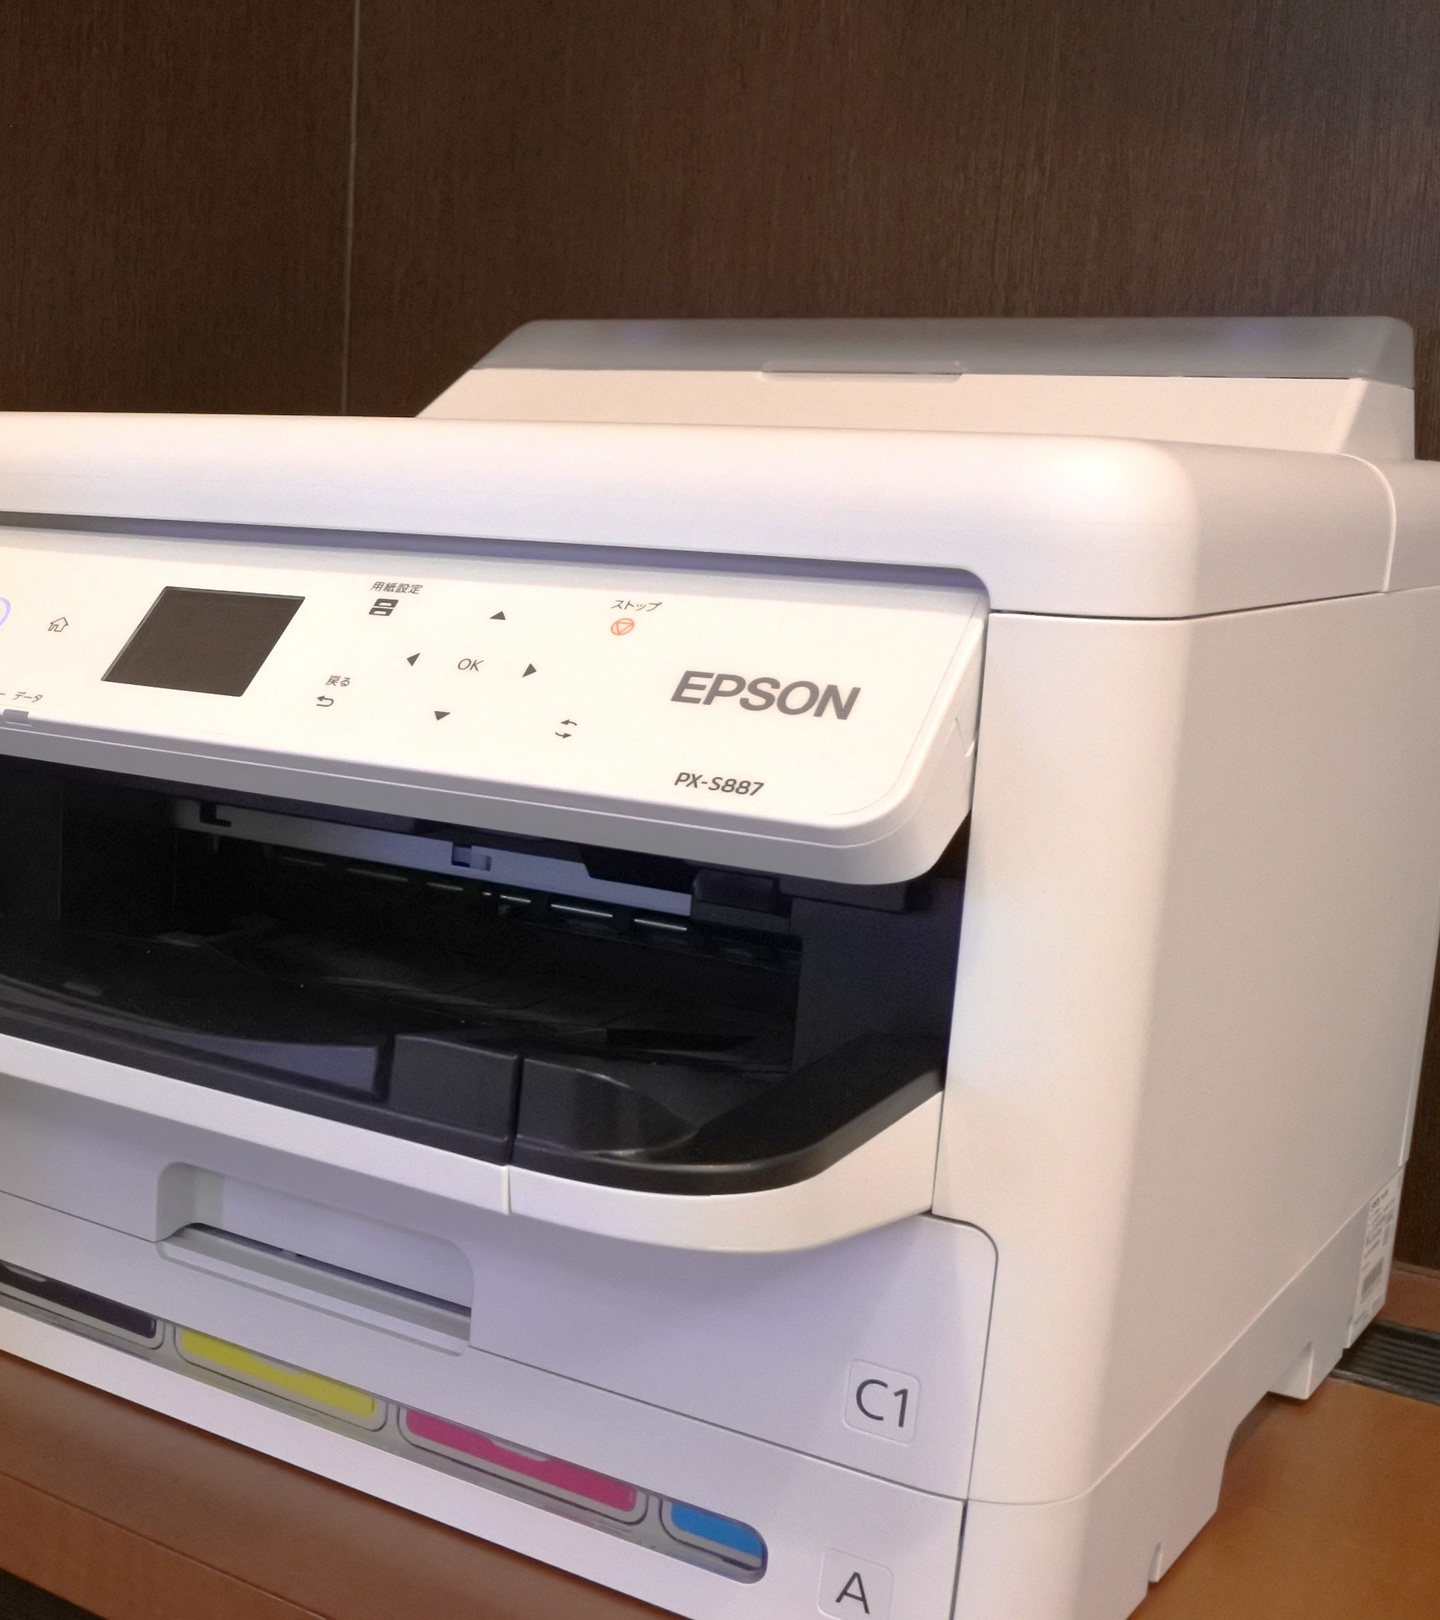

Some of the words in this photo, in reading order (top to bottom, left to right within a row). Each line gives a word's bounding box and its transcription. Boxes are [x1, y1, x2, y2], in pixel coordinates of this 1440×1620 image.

[370, 581, 423, 596] 用紙設定
[610, 598, 662, 613] ストップ
[457, 657, 485, 673] OK
[324, 674, 352, 688] 戻る
[12, 691, 43, 703] データ
[670, 670, 861, 721] EPSON
[674, 772, 764, 797] PX-S887
[855, 1378, 909, 1428] C1
[835, 1571, 870, 1614] A
